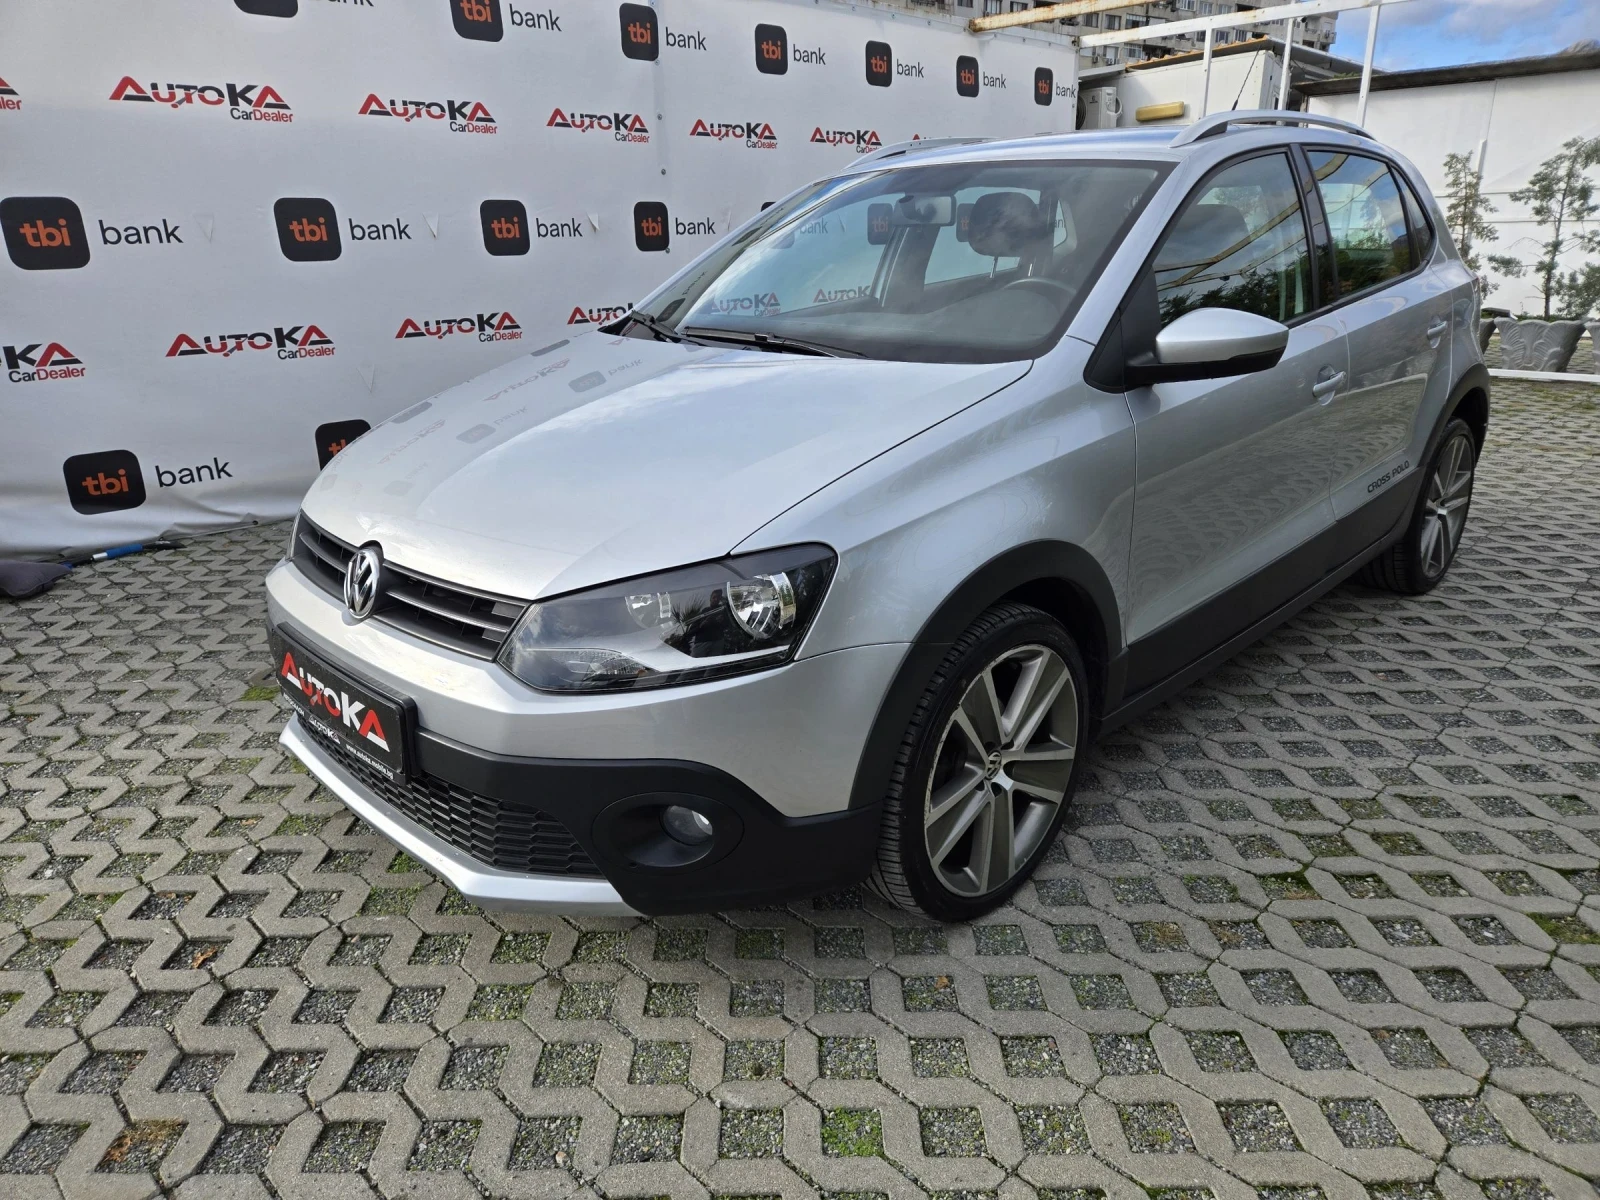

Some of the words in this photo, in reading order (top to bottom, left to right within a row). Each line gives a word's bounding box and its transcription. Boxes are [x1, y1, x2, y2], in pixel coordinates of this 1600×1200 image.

[460, 0, 492, 22] tbi
[510, 4, 562, 32] bank
[628, 22, 651, 44] tbi
[665, 27, 707, 51] bank
[761, 41, 782, 60] tbi
[793, 44, 826, 65] bank
[870, 54, 887, 74] tbi
[896, 60, 924, 78] bank
[960, 69, 975, 85] tbi
[983, 72, 1006, 89] bank
[1055, 82, 1076, 98] bank
[109, 76, 291, 108] AUTOKA
[358, 94, 496, 121] AUTOKA
[546, 108, 648, 132] AUTOKA
[690, 119, 777, 140] AUTOKA
[20, 218, 71, 247] tbi
[99, 219, 183, 245] bank
[289, 217, 327, 242] tbi
[349, 218, 411, 240] bank
[491, 217, 520, 239] tbi
[536, 217, 583, 238] bank
[642, 218, 662, 236] tbi
[675, 217, 716, 236] bank
[801, 216, 828, 235] bank
[872, 215, 889, 232] tbi
[395, 312, 521, 340] AUTOKA
[166, 325, 334, 357] AUTOKA
[8, 366, 85, 382] CarDealer
[82, 469, 129, 496] tbi
[156, 457, 233, 487] bank
[1367, 472, 1391, 493] CROSS
[1392, 460, 1410, 477] POLO
